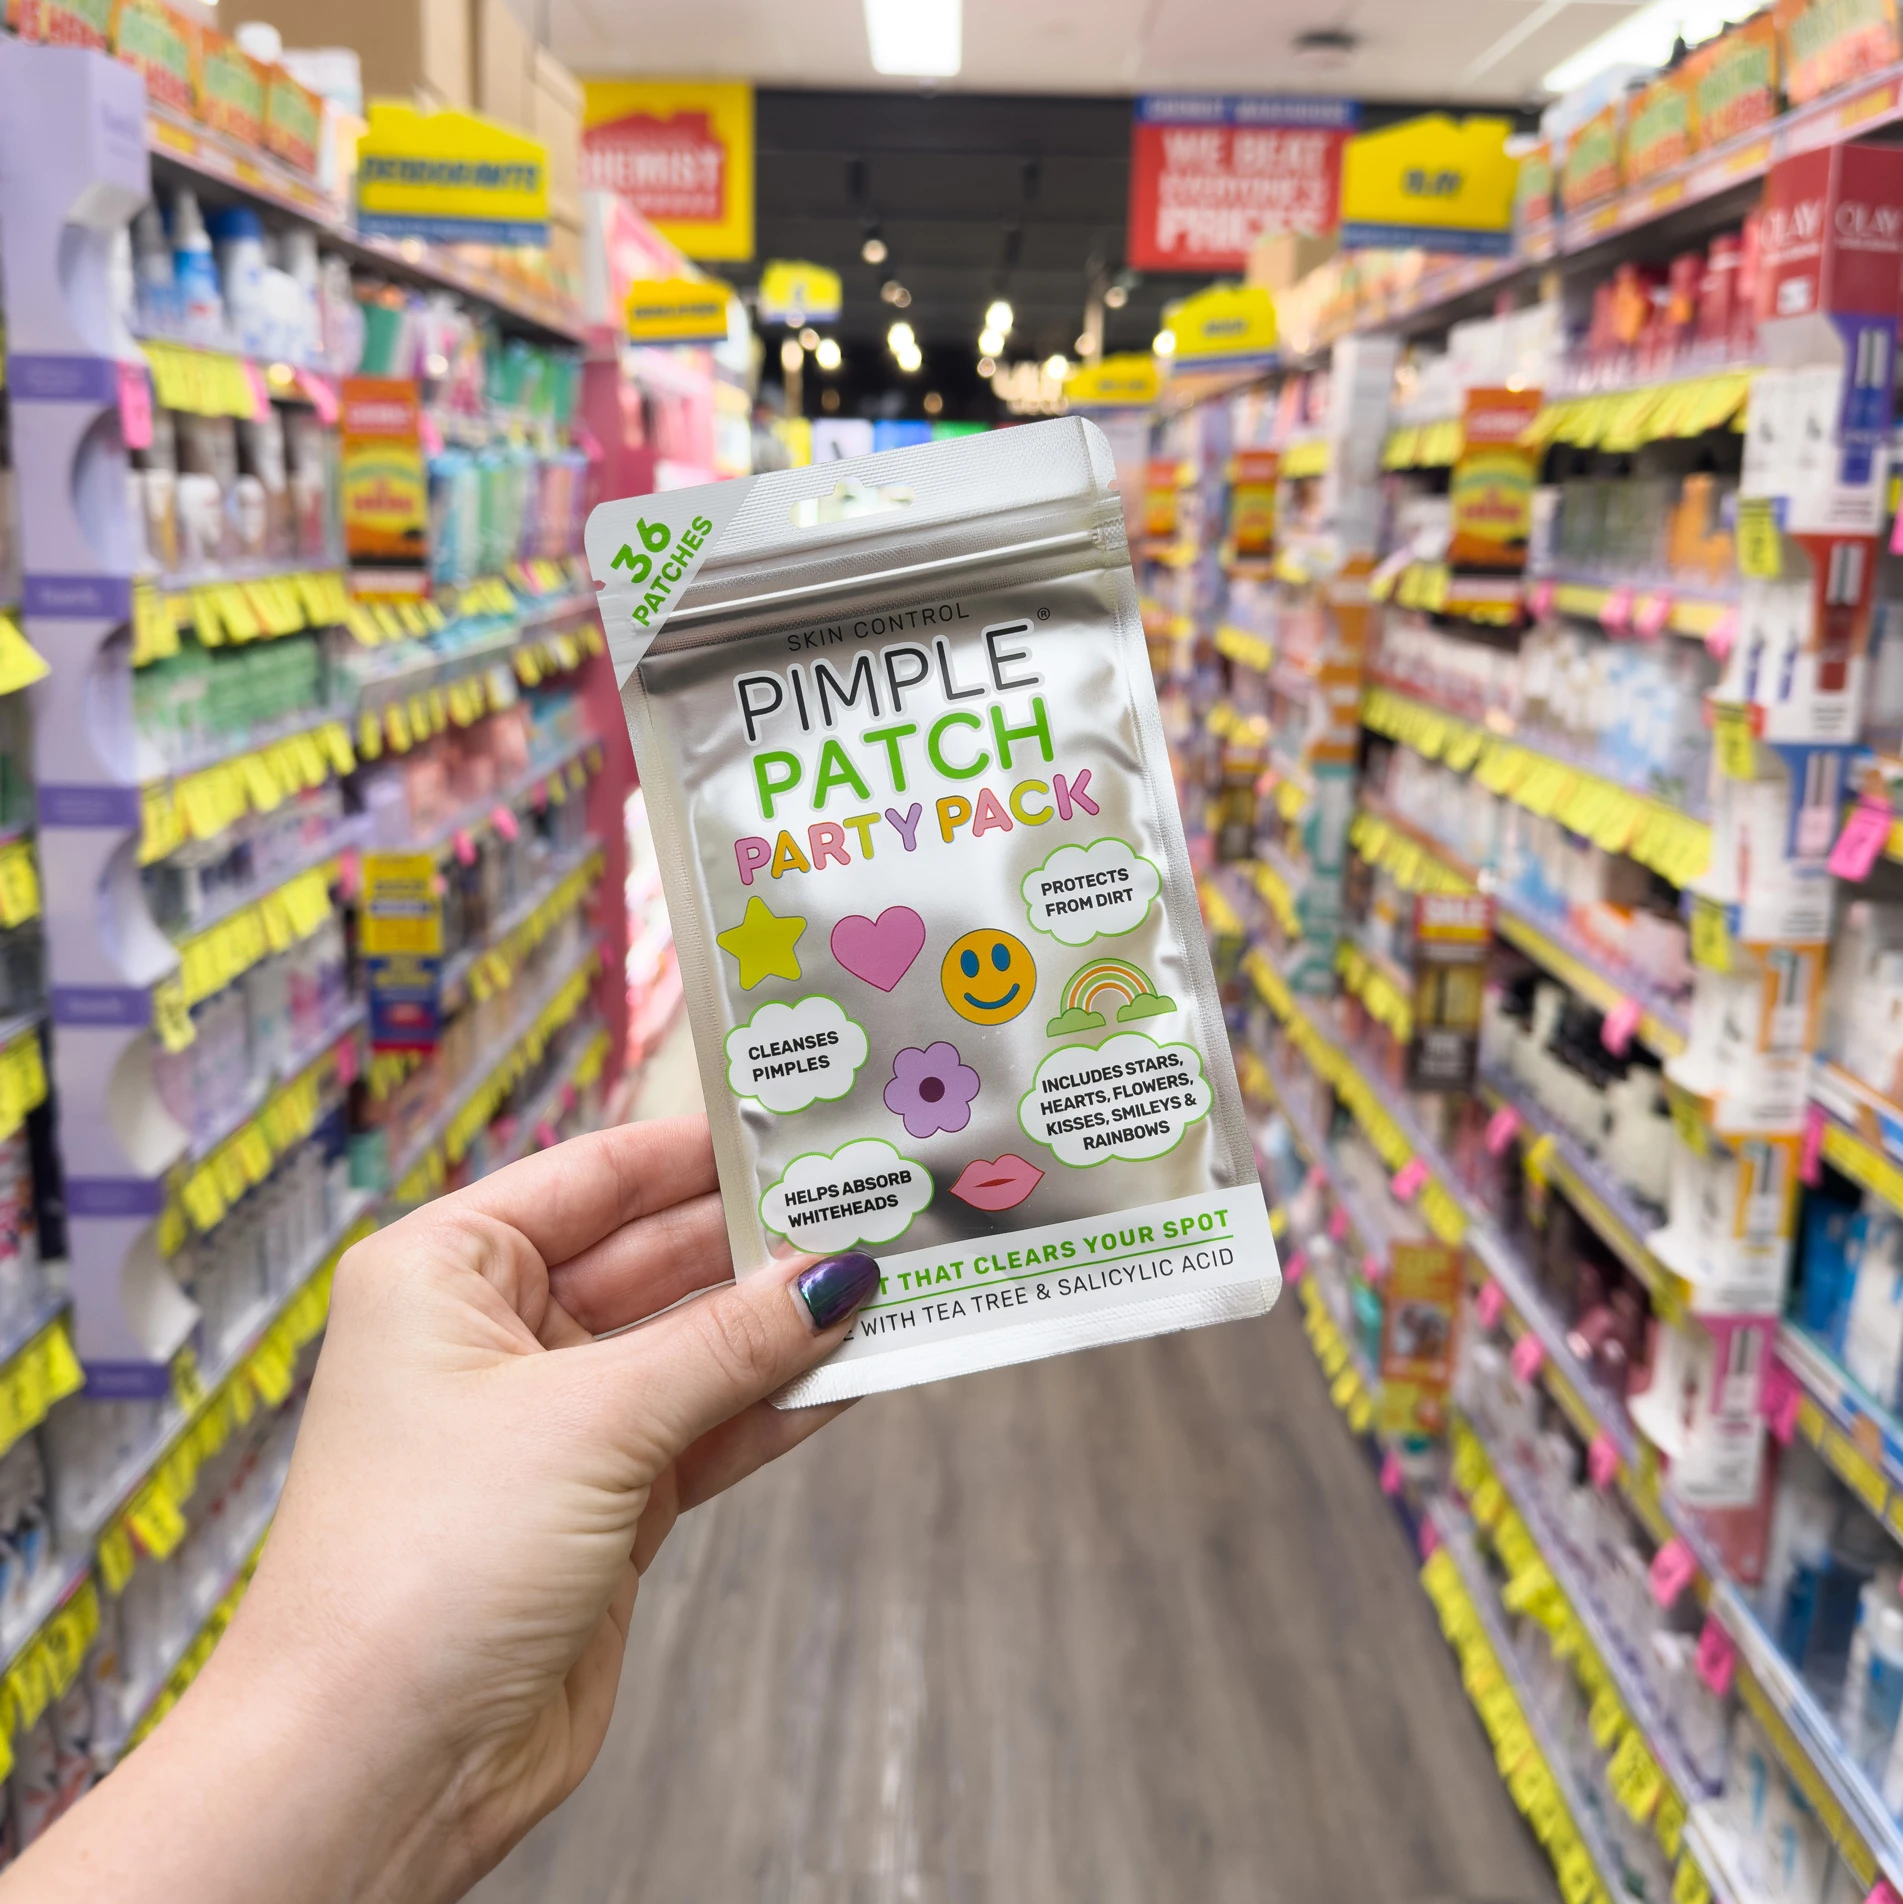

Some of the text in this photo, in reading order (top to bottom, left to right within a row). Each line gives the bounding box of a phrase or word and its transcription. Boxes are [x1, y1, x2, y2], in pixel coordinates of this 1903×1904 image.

[610, 516, 673, 585] 36
[631, 515, 713, 627] PATCHES
[787, 602, 970, 652] SKIN CONTROL
[737, 624, 1040, 742] PIMPLE
[753, 697, 1054, 819] PATCH
[733, 768, 1101, 887] PARTY PACK
[1041, 868, 1129, 896] PROTECTS
[1045, 887, 1133, 917] FROM DIRT
[748, 1030, 839, 1061] CLEANSES
[752, 1054, 831, 1082] PIMPLES
[1042, 1053, 1184, 1094] INCLUDES STARS,
[1040, 1072, 1195, 1116] HEARTS, FLOWERS,
[1046, 1093, 1197, 1137] KISSES, SMILEYS &
[1082, 1120, 1170, 1151] RAINBOWS
[784, 1170, 912, 1207] HELPS ABSORB
[787, 1194, 899, 1228] WHITEHEADS
[897, 1261, 964, 1291] THAT
[973, 1241, 1077, 1275] CLEARS
[1083, 1226, 1155, 1254] YOUR
[1163, 1209, 1228, 1239] SPOT
[860, 1310, 916, 1337] WITH
[921, 1300, 966, 1323] TEA
[970, 1286, 1028, 1313] TREE
[1036, 1283, 1051, 1300] &
[1058, 1259, 1173, 1296] SALICYLIC
[1182, 1248, 1233, 1273] ACID
